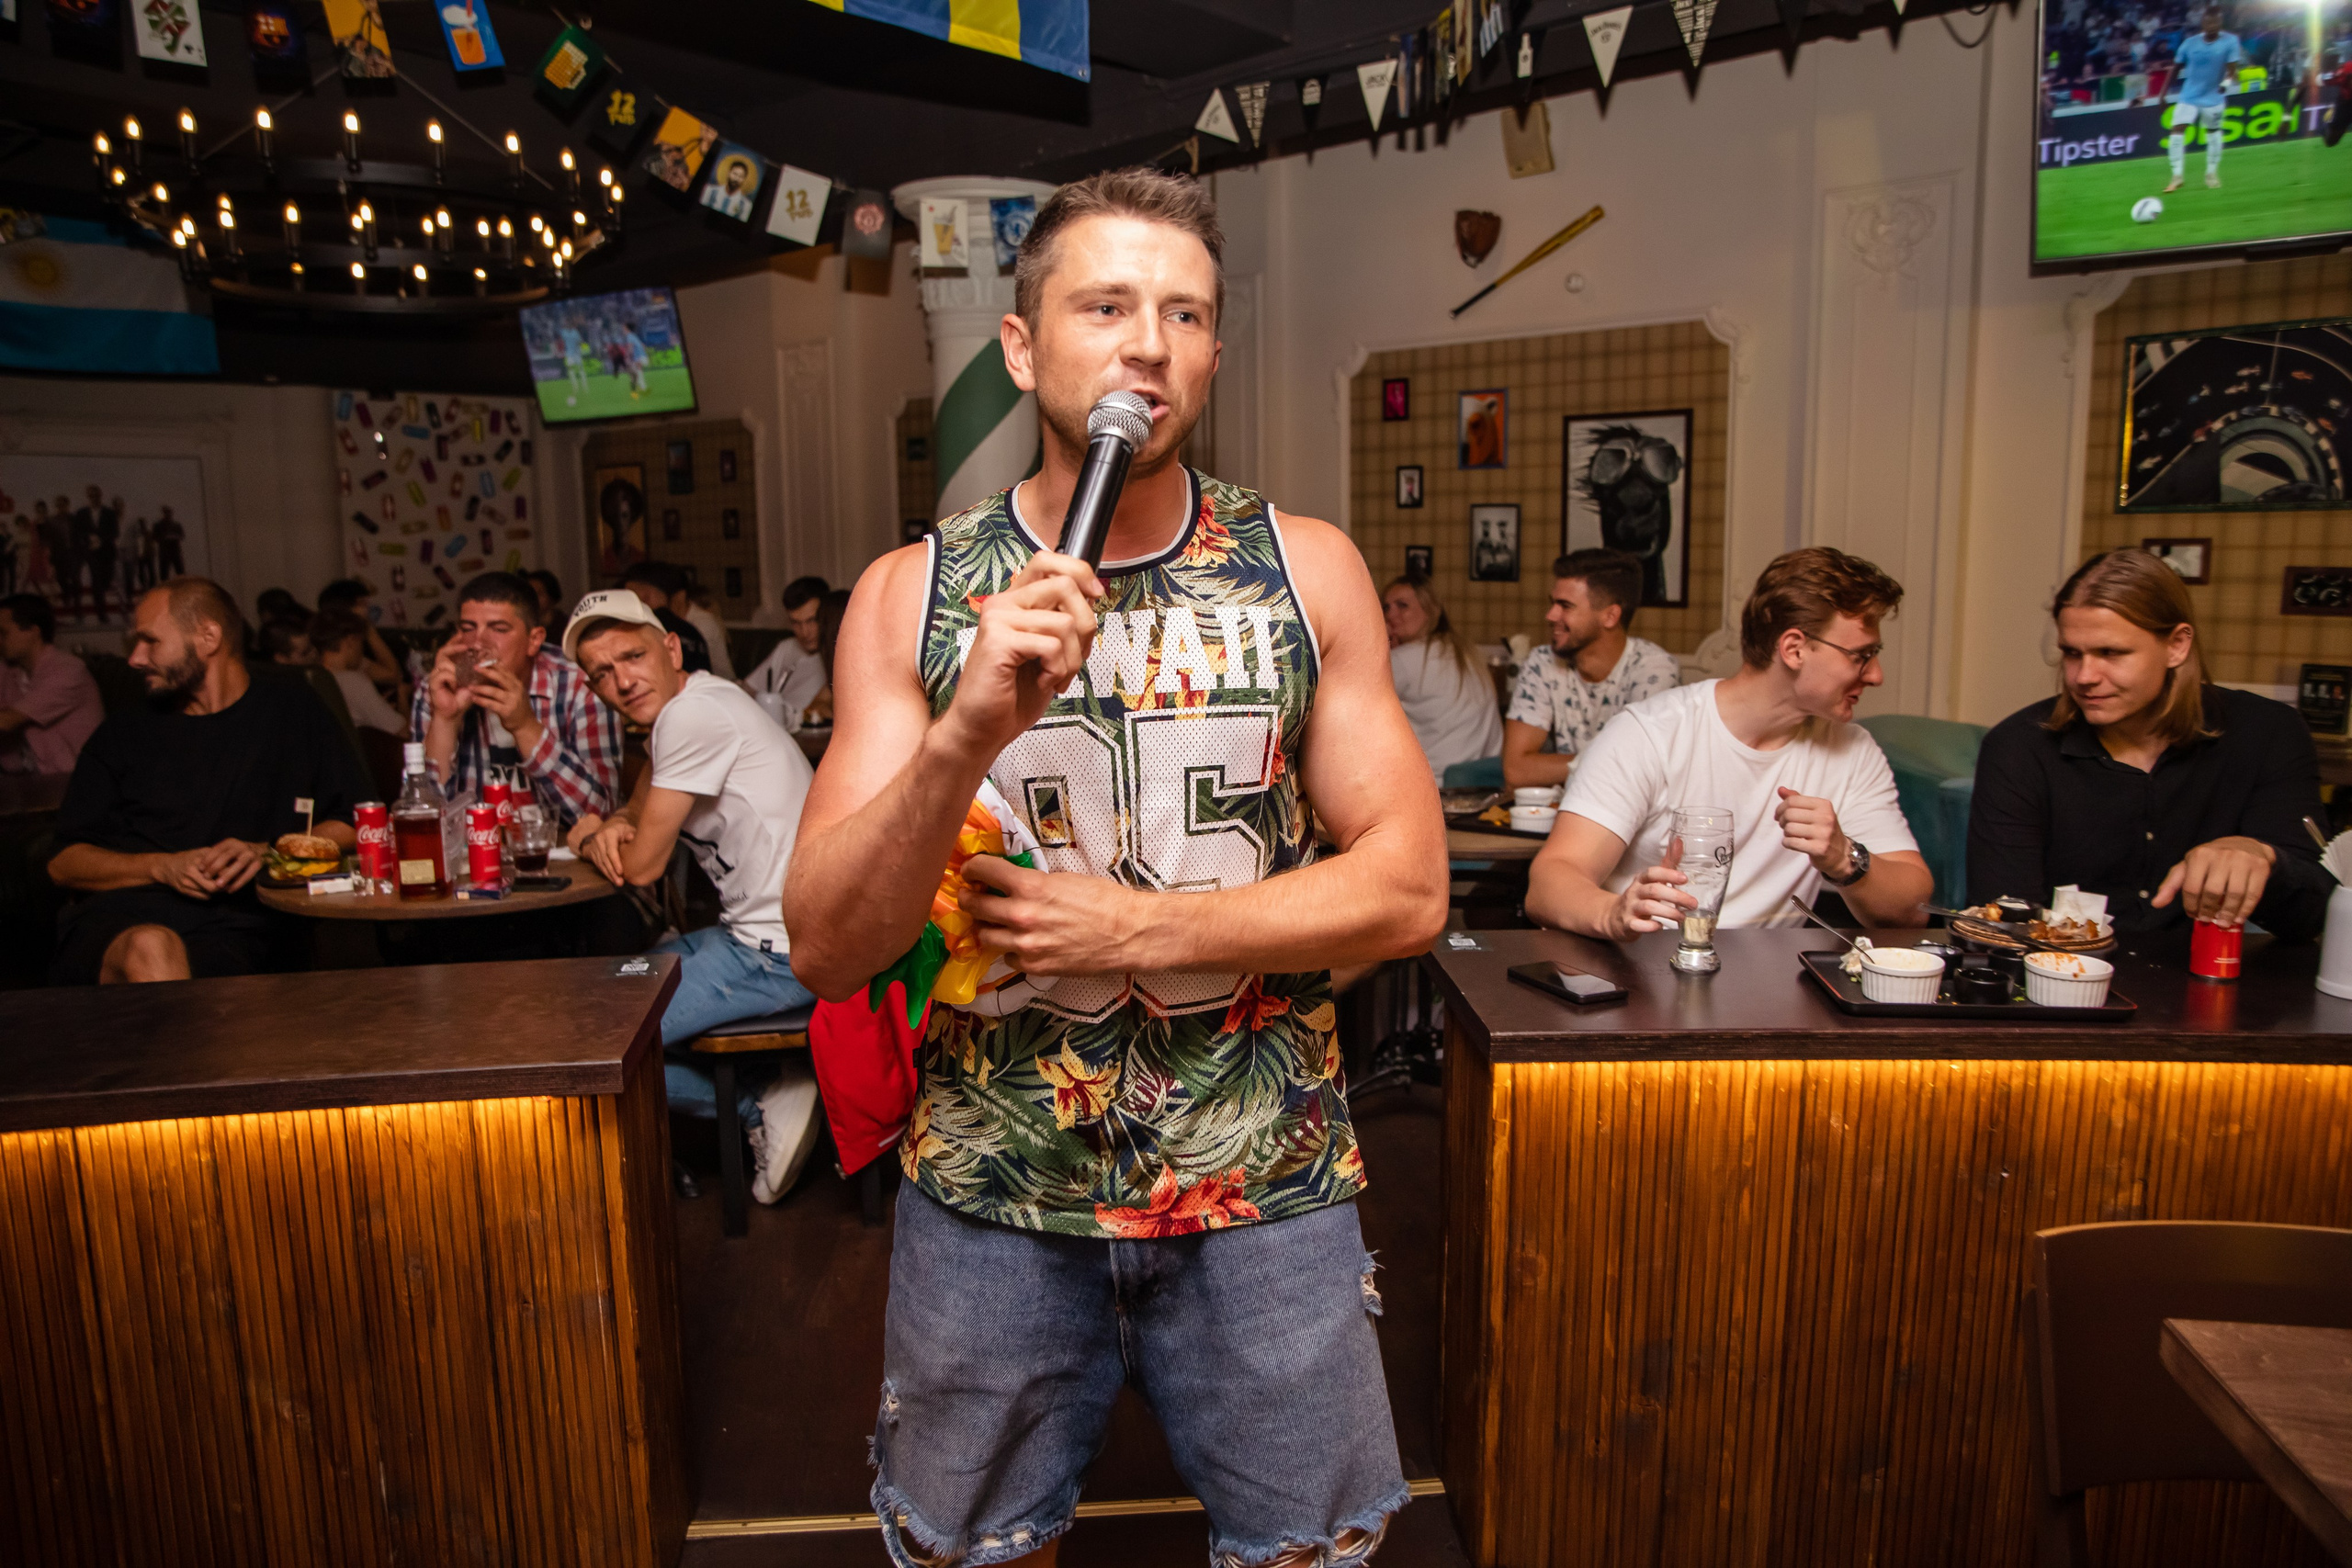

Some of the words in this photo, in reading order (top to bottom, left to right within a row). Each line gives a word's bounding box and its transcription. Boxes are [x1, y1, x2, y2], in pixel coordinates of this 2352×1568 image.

[2039, 133, 2139, 167] Tipster
[786, 189, 808, 209] 12
[956, 605, 1280, 699] WAII
